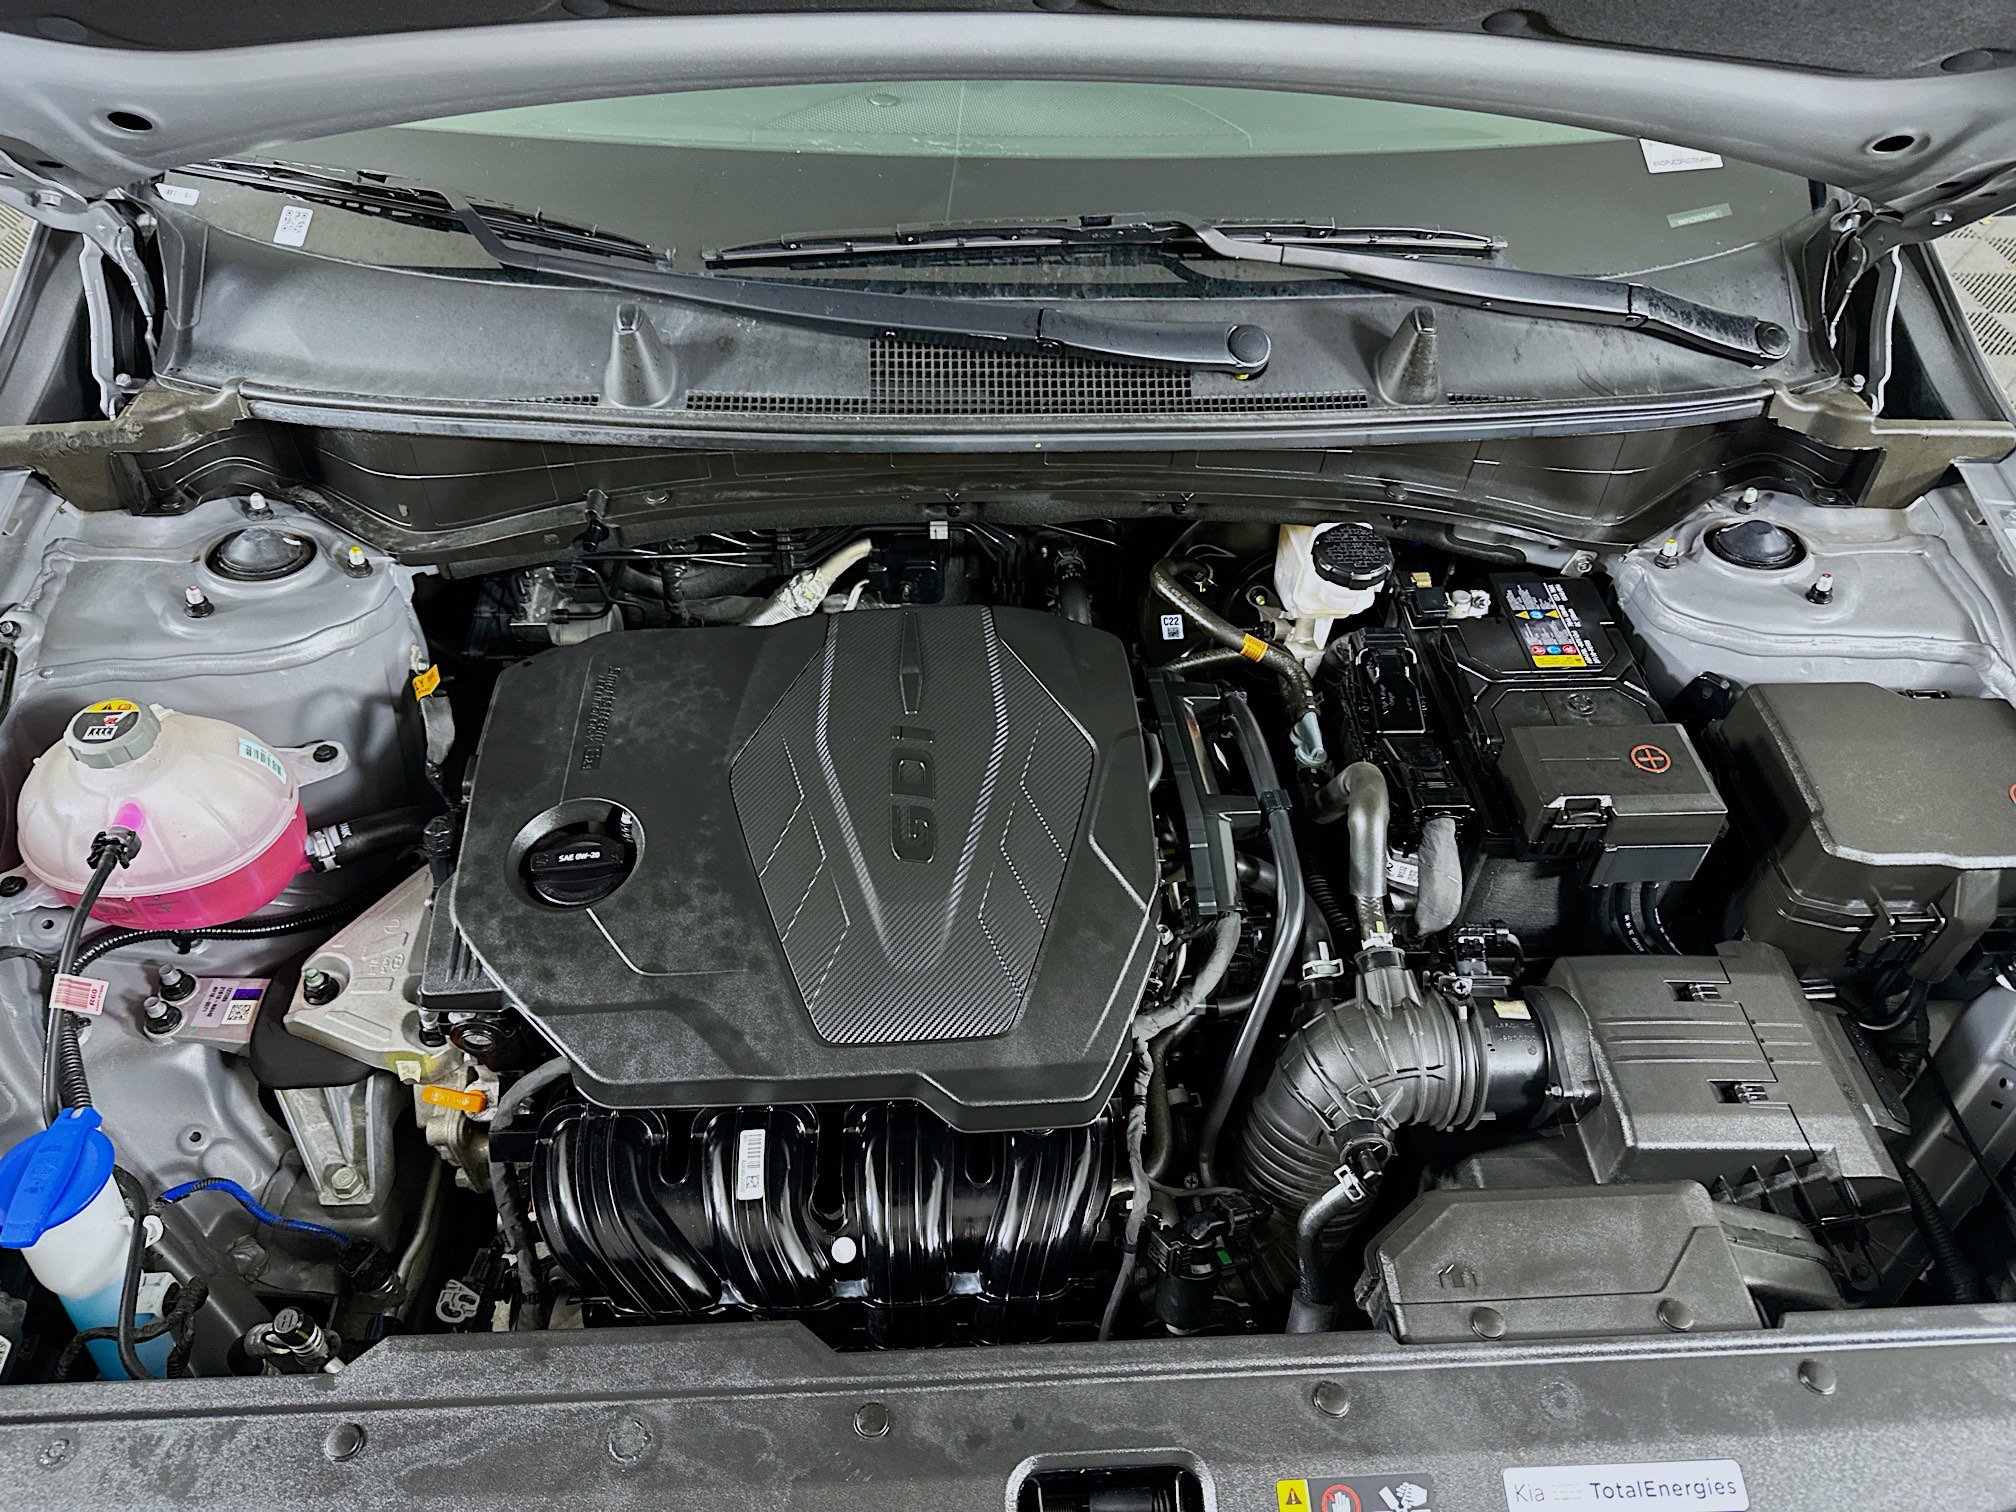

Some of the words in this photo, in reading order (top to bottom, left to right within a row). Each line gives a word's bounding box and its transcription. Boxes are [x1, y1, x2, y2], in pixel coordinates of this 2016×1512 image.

[1163, 616, 1179, 626] C22
[558, 853, 575, 862] SAE
[1514, 1483, 1545, 1502] Kia
[1589, 1477, 1737, 1500] TotalEnergies
